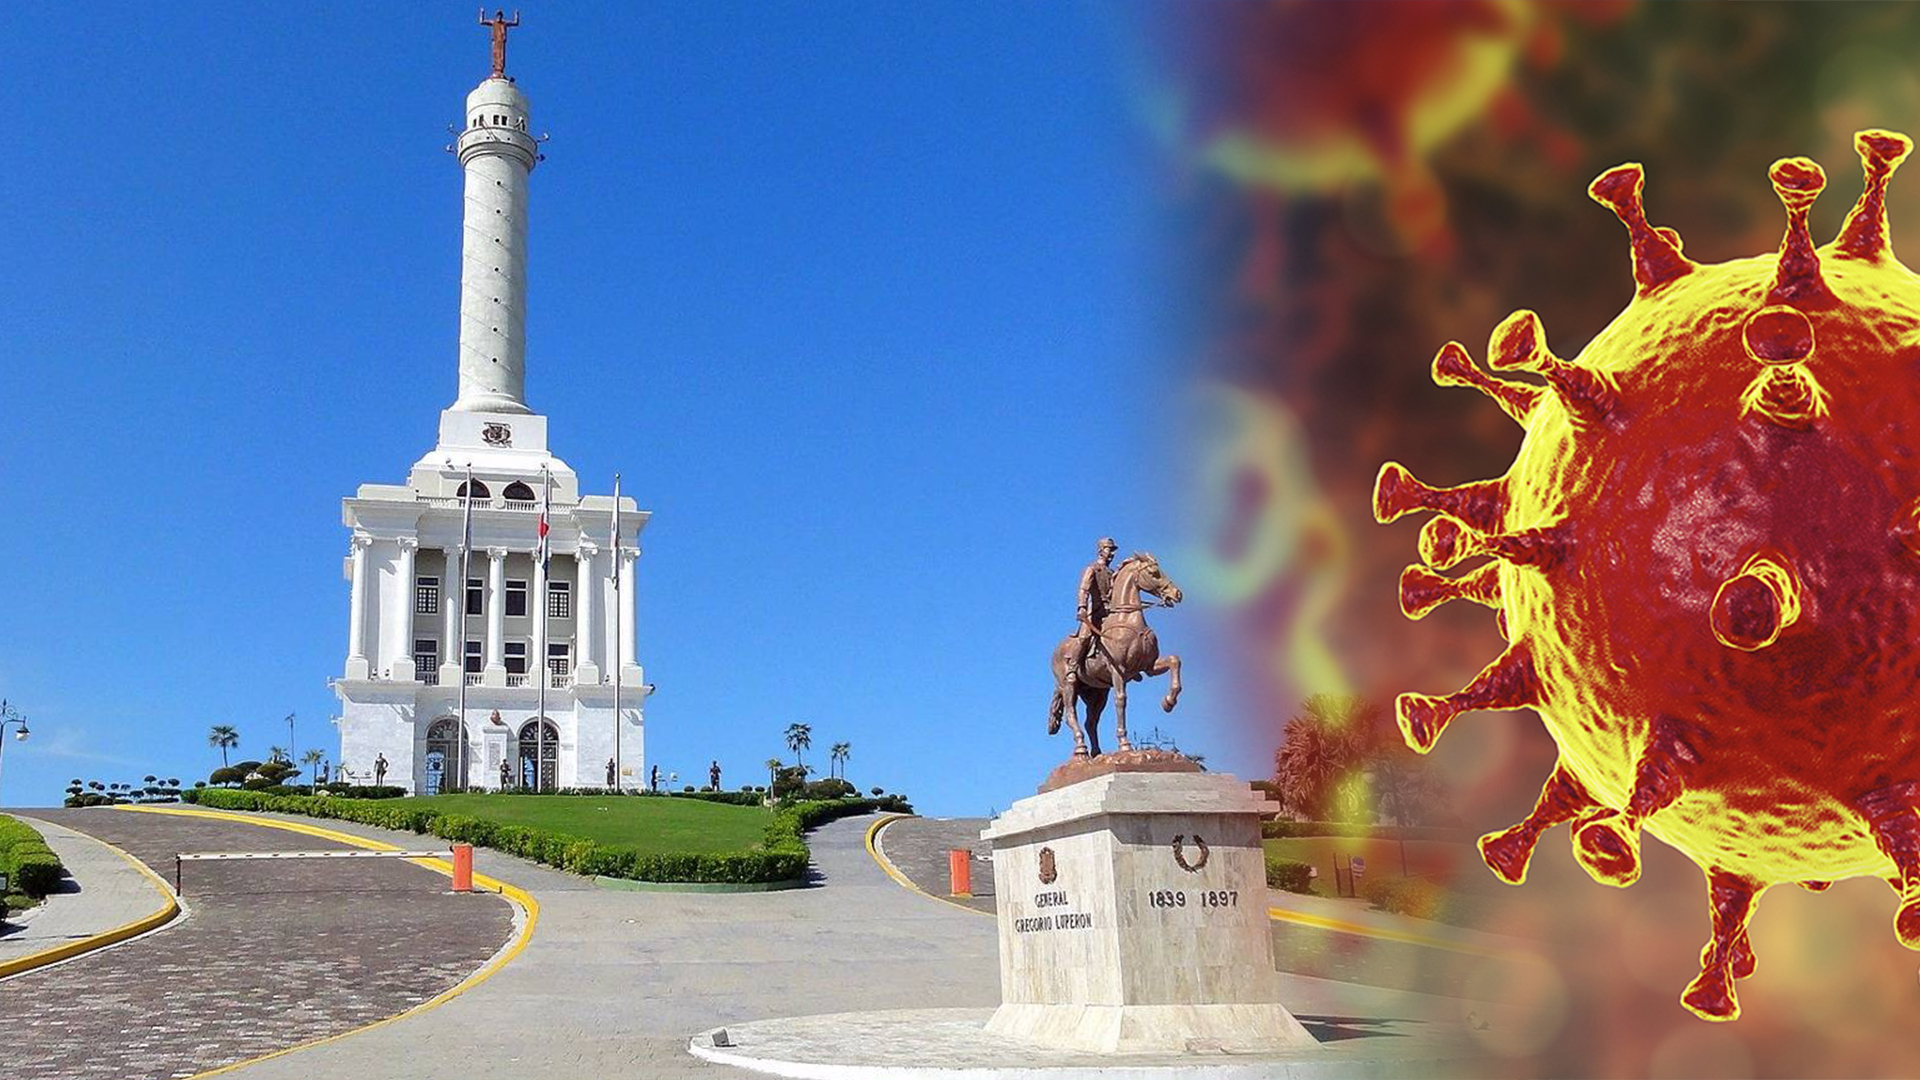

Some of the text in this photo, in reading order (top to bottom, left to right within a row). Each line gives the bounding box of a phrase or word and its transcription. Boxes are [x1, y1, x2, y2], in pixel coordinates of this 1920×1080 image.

[1034, 891, 1068, 908] GENERAL
[1149, 890, 1238, 908] 1839 1897
[1015, 913, 1092, 933] GREGORIO LUPERON
